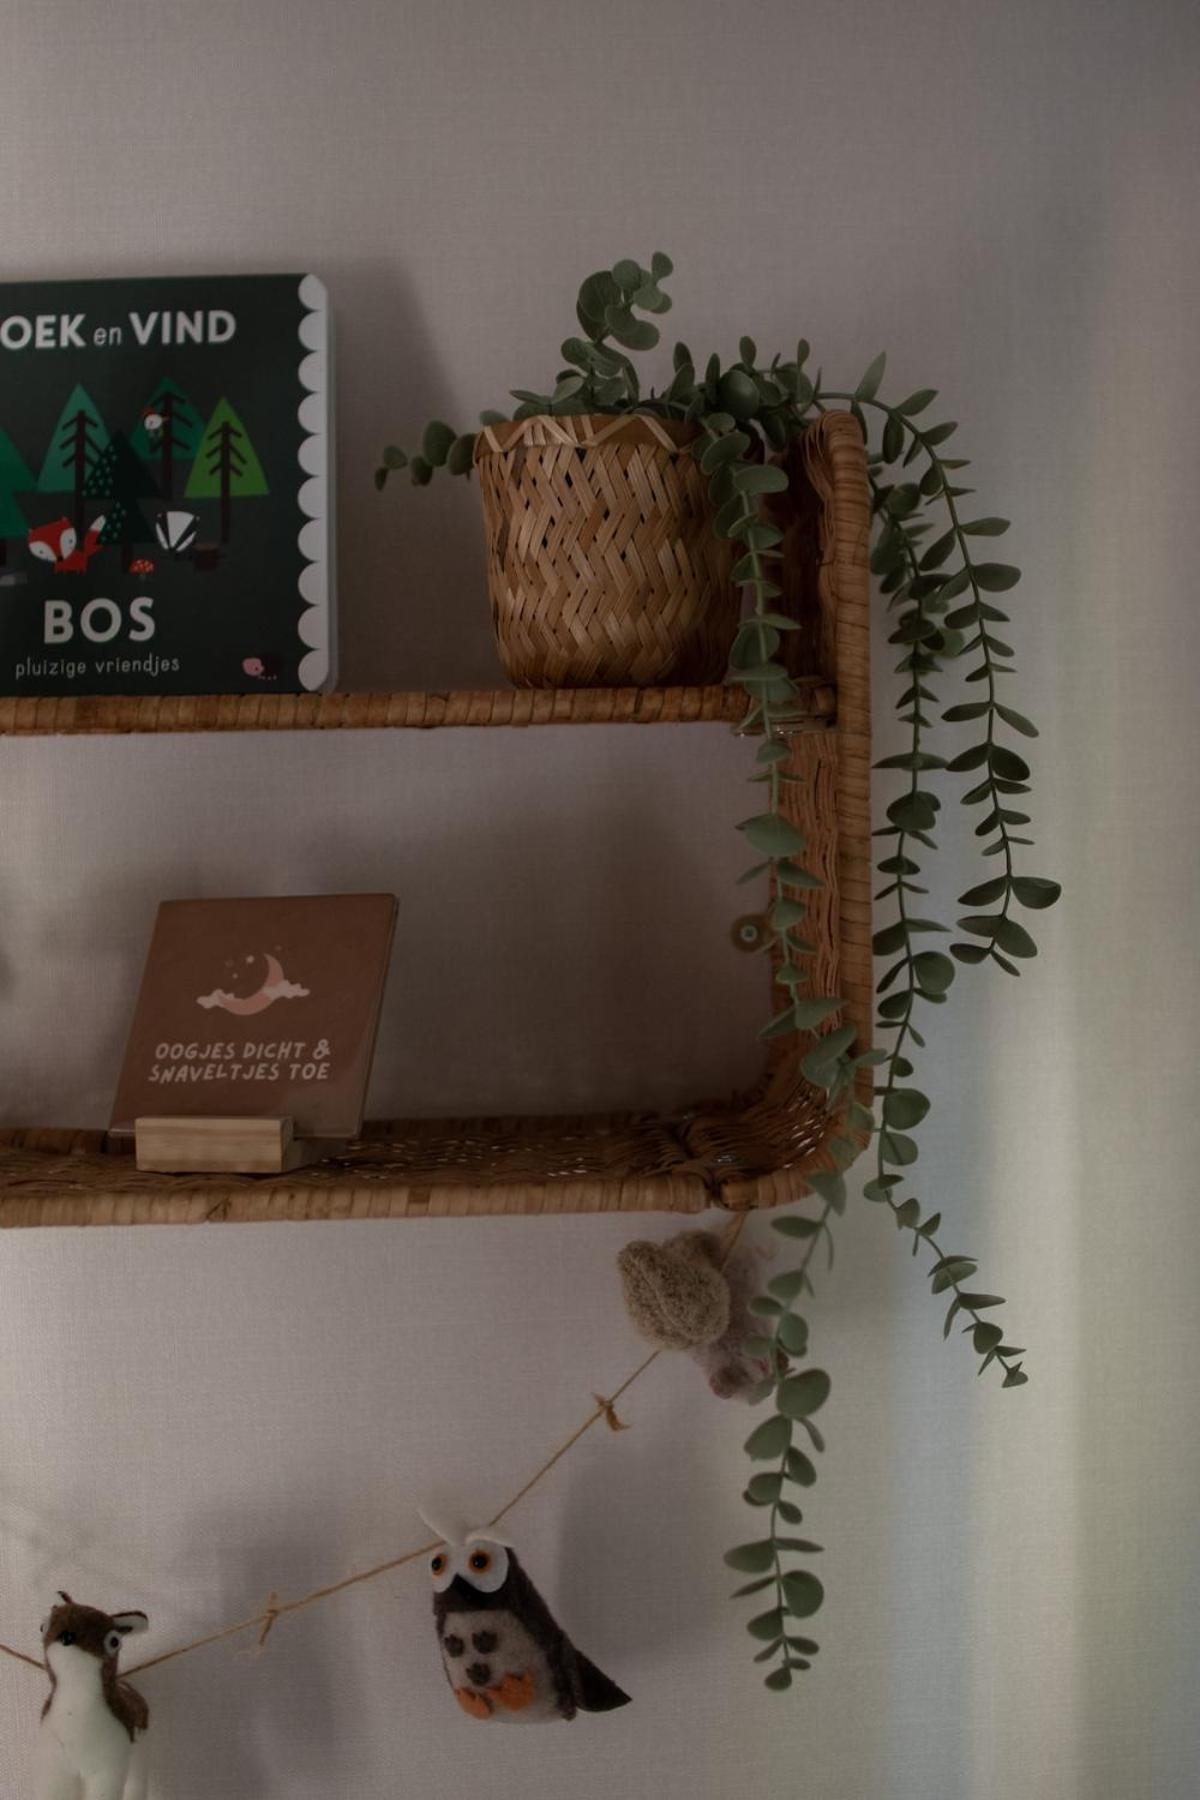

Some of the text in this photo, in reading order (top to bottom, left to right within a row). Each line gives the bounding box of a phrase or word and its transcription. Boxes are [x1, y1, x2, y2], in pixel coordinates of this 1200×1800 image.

[0, 309, 236, 350] OEK en VIND
[43, 596, 156, 644] BOS
[15, 653, 180, 680] pluizige vriendjes
[155, 1038, 331, 1060] OOGJES DICHT &
[148, 1062, 330, 1083] SNAVELTJES TOE
